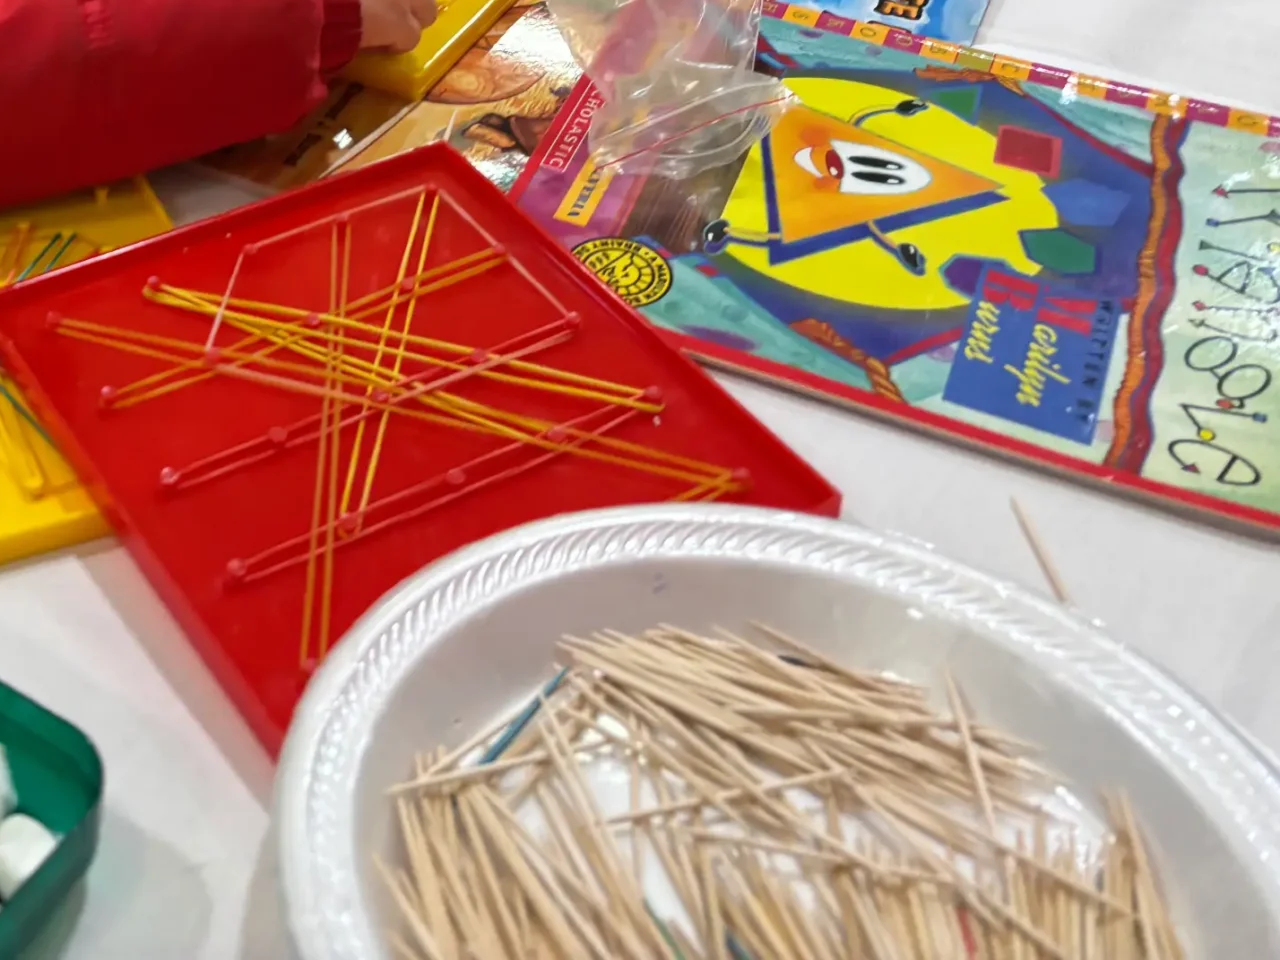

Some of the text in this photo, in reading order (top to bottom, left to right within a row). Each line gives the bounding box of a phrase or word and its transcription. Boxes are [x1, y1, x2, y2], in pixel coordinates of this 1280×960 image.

[549, 88, 602, 169] HOLASTIC
[963, 268, 1041, 365] Burns
[1004, 296, 1099, 408] Marilyn
